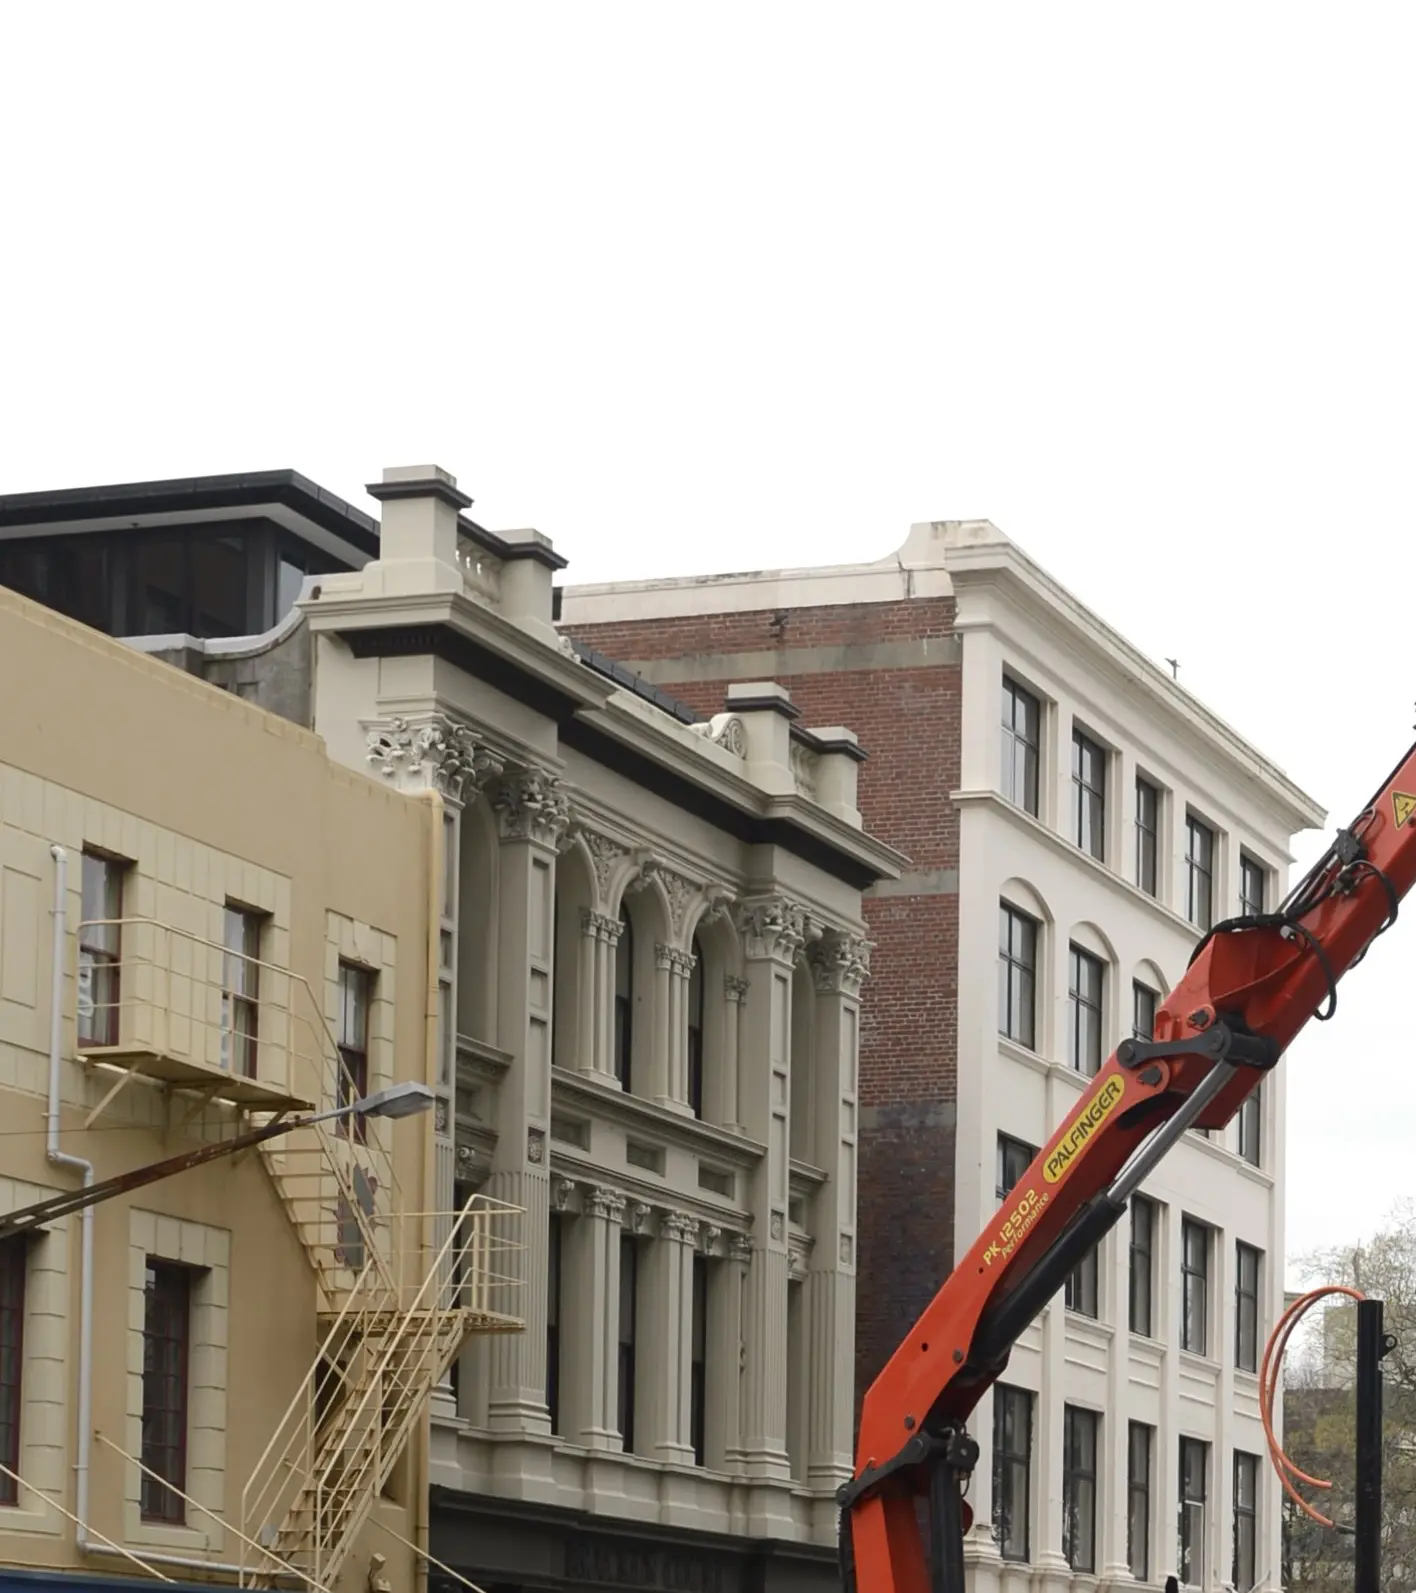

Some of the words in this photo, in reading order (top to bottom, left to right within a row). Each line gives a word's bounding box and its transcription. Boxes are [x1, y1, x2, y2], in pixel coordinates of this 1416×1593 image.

[1047, 1081, 1121, 1178] PALFINGER
[983, 1240, 1001, 1266] PK
[1000, 1189, 1038, 1243] 12502
